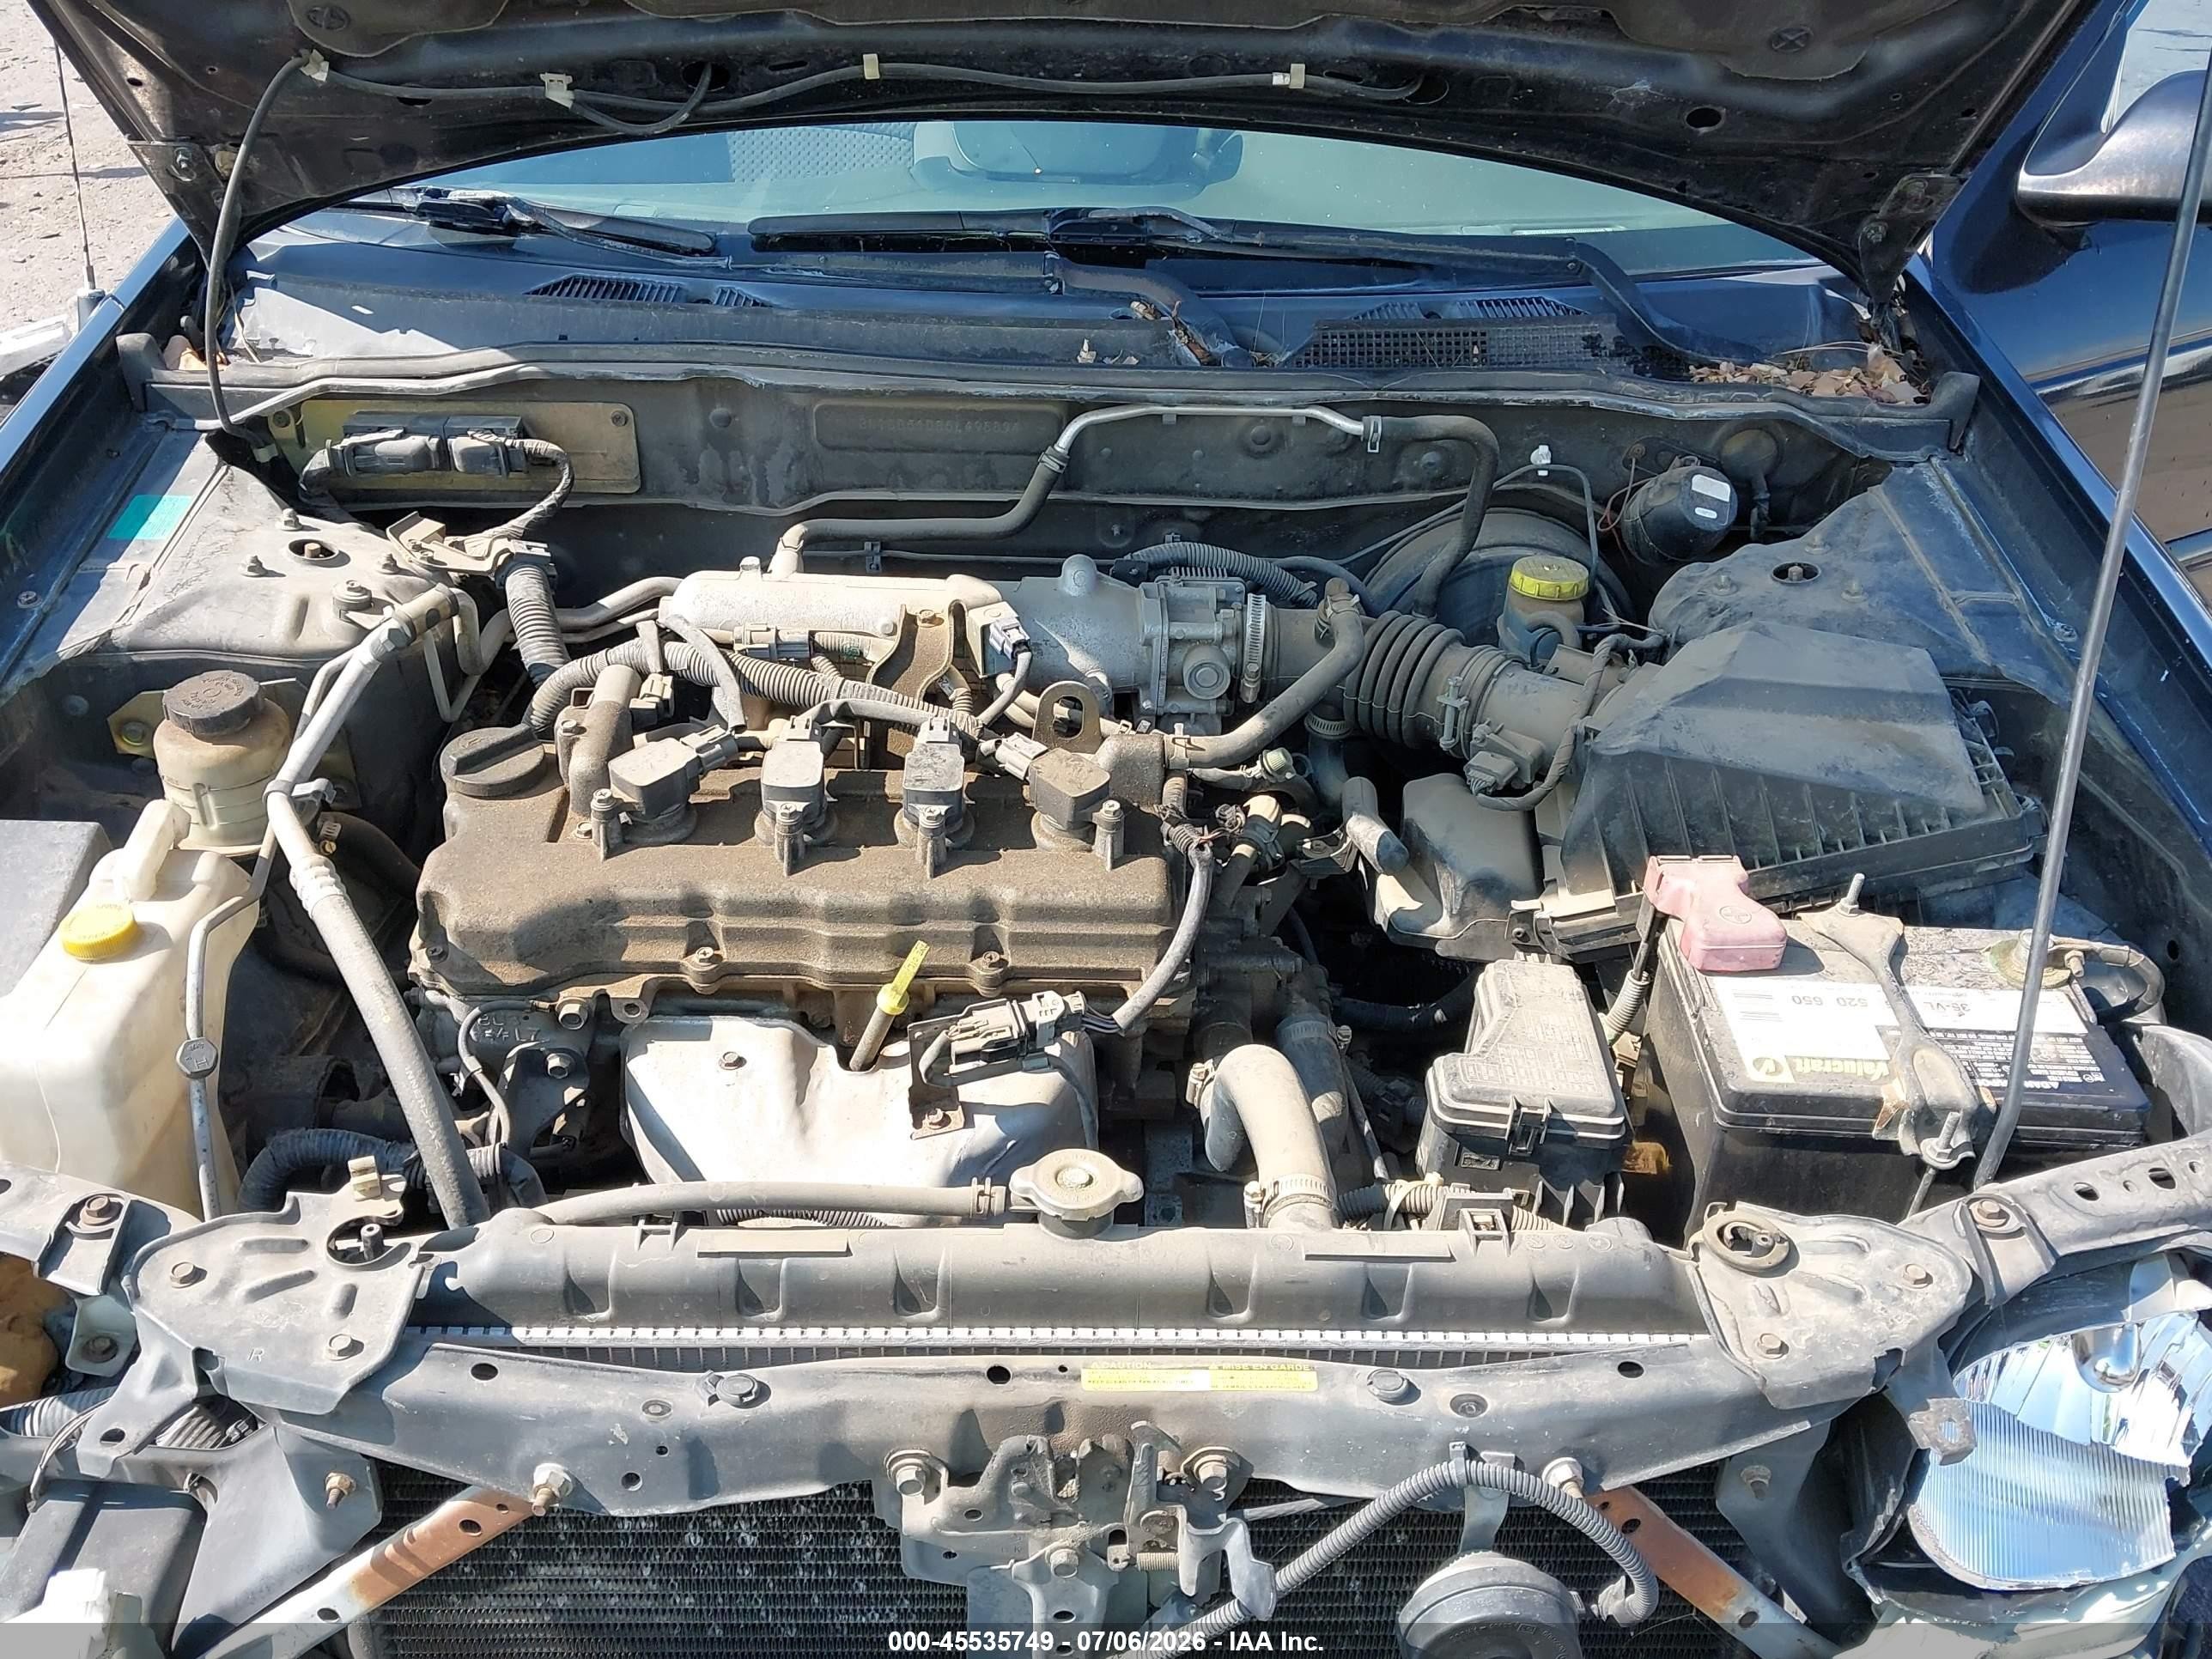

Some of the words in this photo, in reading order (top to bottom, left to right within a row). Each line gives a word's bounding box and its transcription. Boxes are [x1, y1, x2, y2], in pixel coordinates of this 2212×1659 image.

[1792, 995, 1824, 1006] 650
[1836, 996, 1869, 1008] 520
[246, 1347, 265, 1362] R
